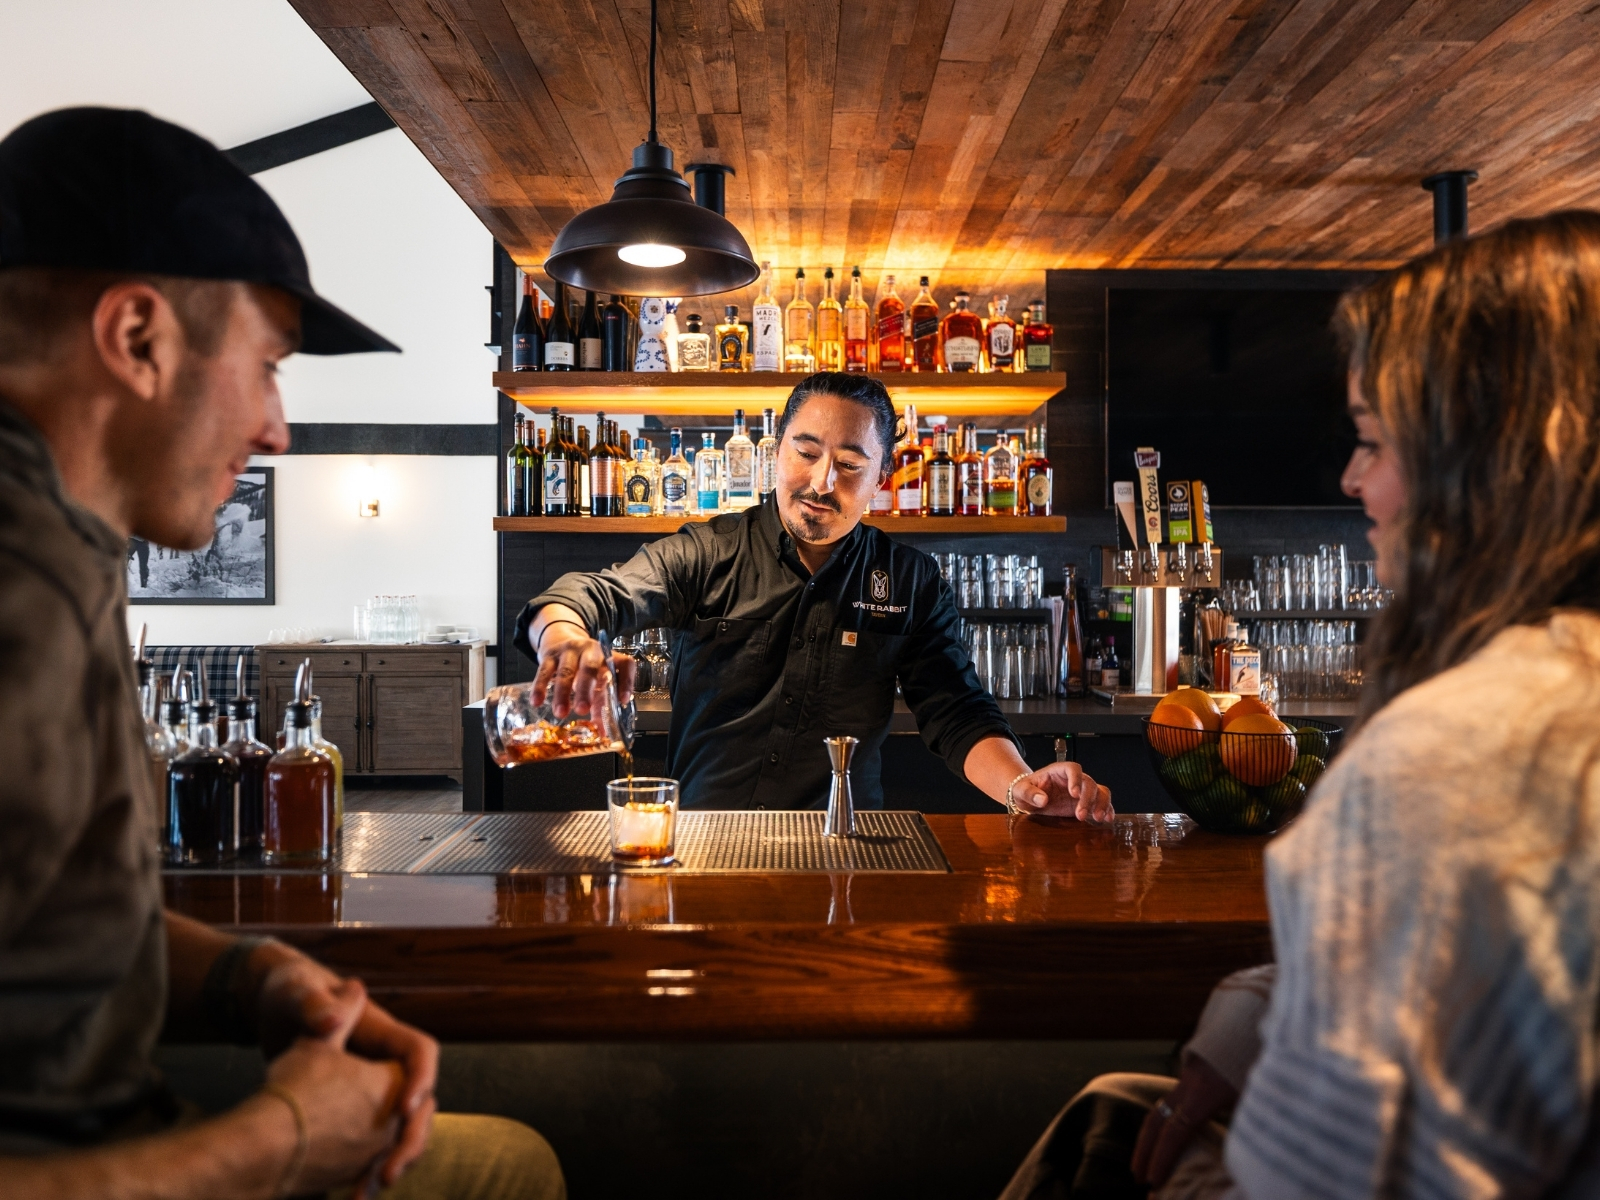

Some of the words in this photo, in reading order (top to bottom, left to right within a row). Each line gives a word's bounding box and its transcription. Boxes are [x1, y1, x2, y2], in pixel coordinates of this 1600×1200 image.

[1145, 474, 1159, 513] Coors
[852, 601, 875, 610] WHITE
[1233, 656, 1244, 664] THE
